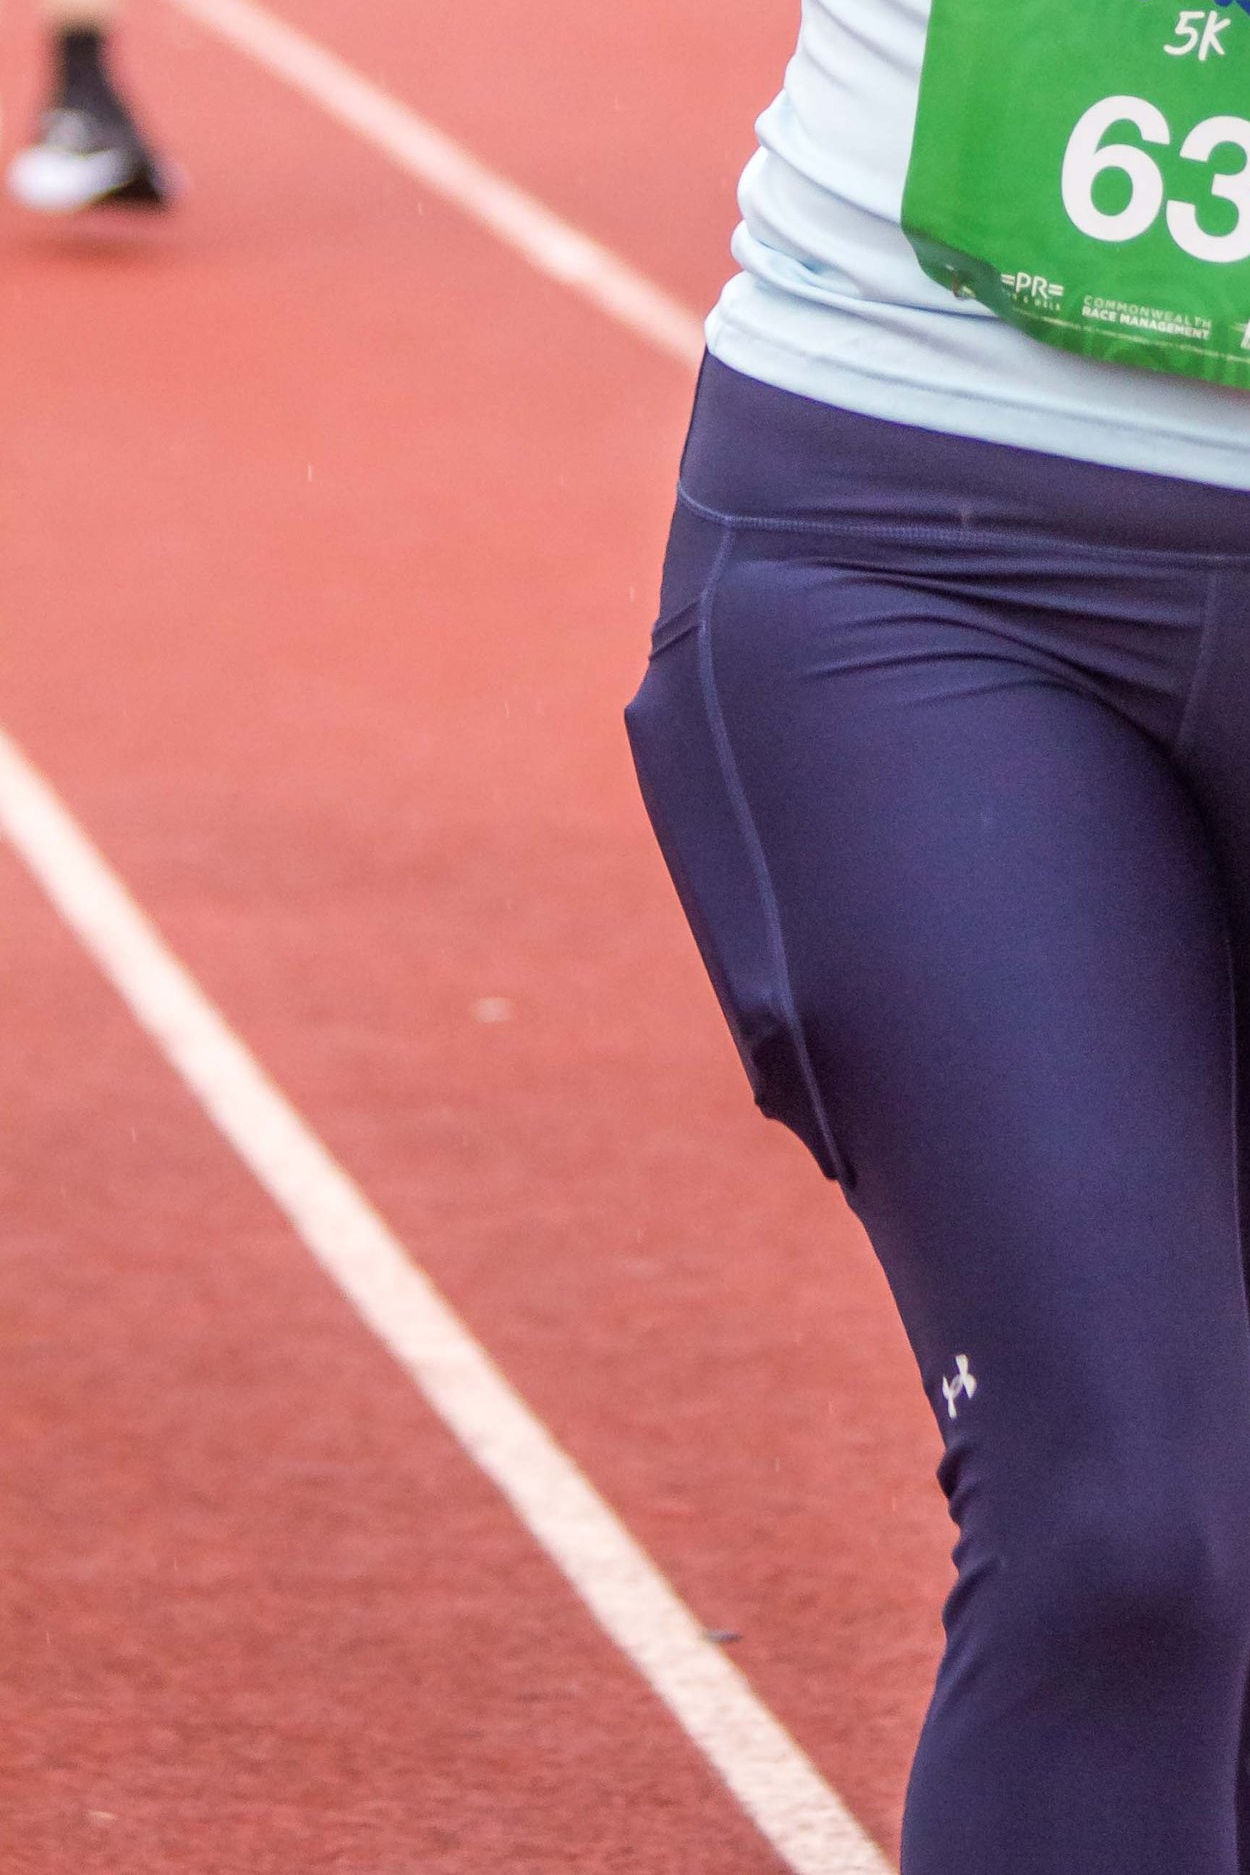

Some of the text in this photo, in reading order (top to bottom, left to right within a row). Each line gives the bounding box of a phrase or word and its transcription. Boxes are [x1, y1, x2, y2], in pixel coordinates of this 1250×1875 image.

[1163, 10, 1231, 61] 5K
[1082, 305, 1211, 341] RACE MANAGEMENT
[1083, 294, 1212, 330] COMMONWEALTH
